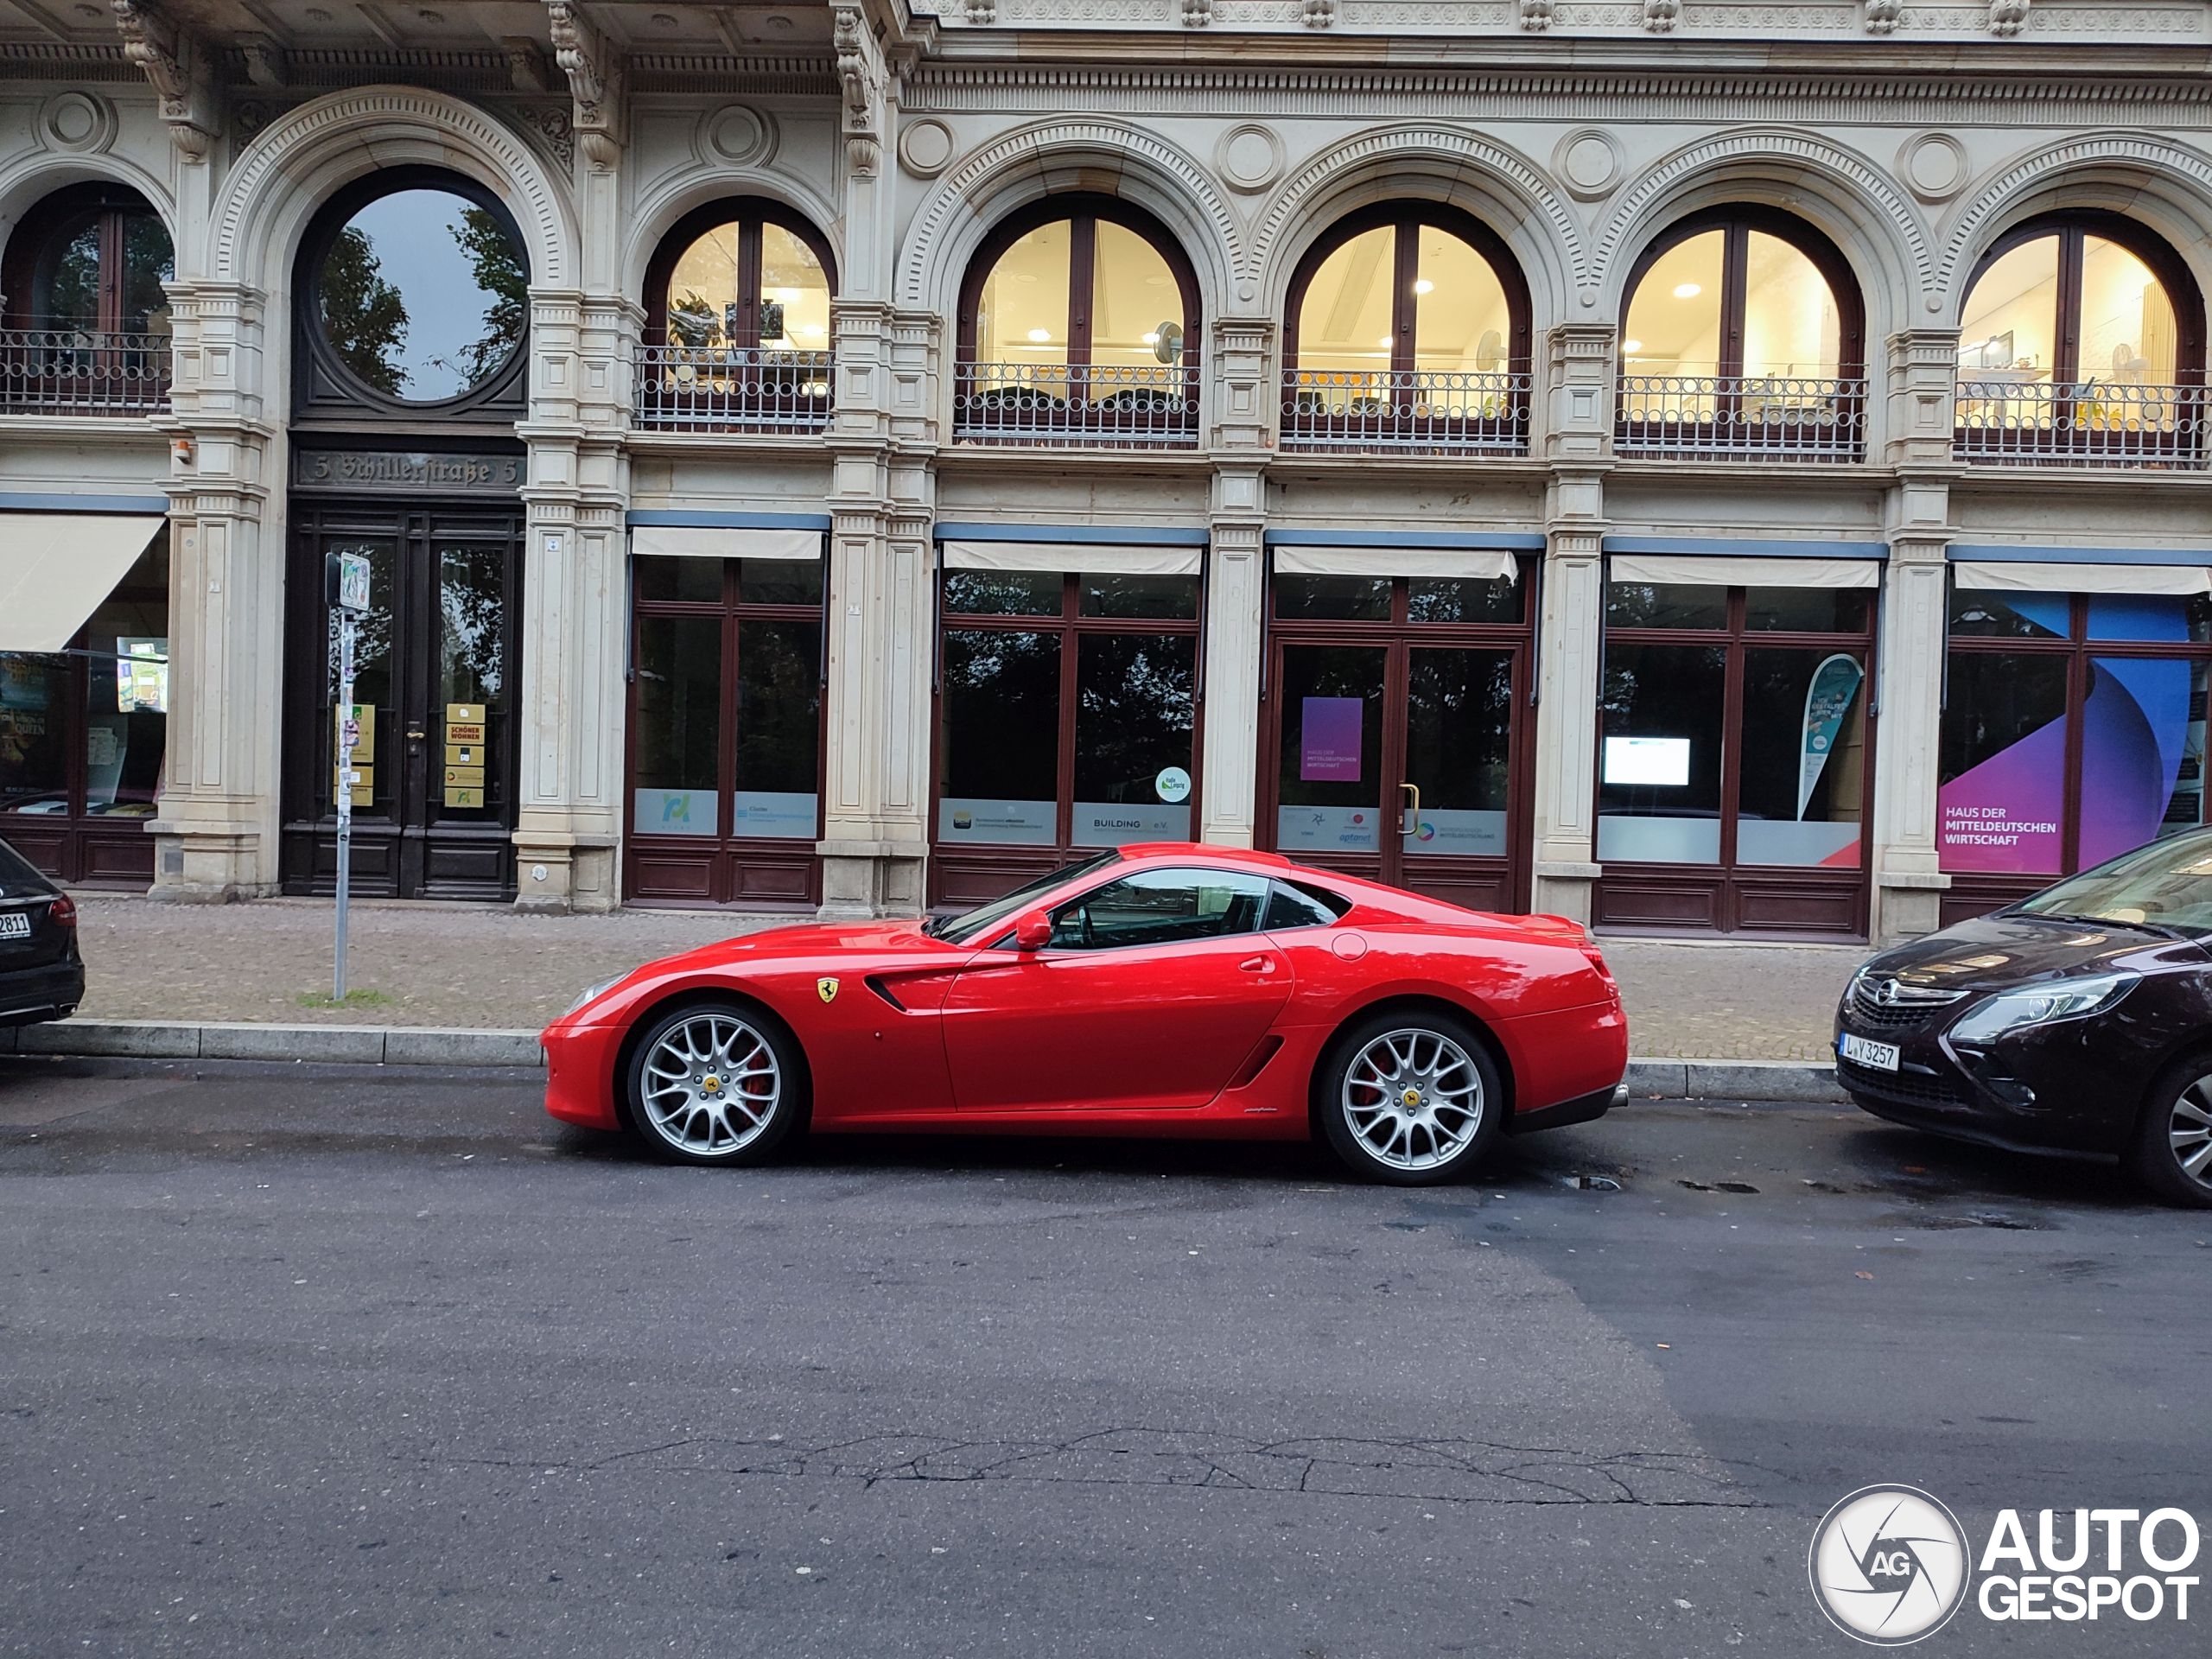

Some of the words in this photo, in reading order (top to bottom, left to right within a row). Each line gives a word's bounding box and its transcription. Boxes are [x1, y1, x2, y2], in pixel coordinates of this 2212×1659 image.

[315, 455, 330, 479] 5
[504, 461, 519, 484] 5
[15, 722, 46, 735] QUEEN
[1946, 807, 1980, 818] HAUS
[1981, 808, 2006, 818] DER
[1093, 818, 1141, 829] BUILDING
[1945, 820, 2056, 834] MITTELDEUTSCHEN
[1945, 834, 2019, 846] WIRTSCHAFT
